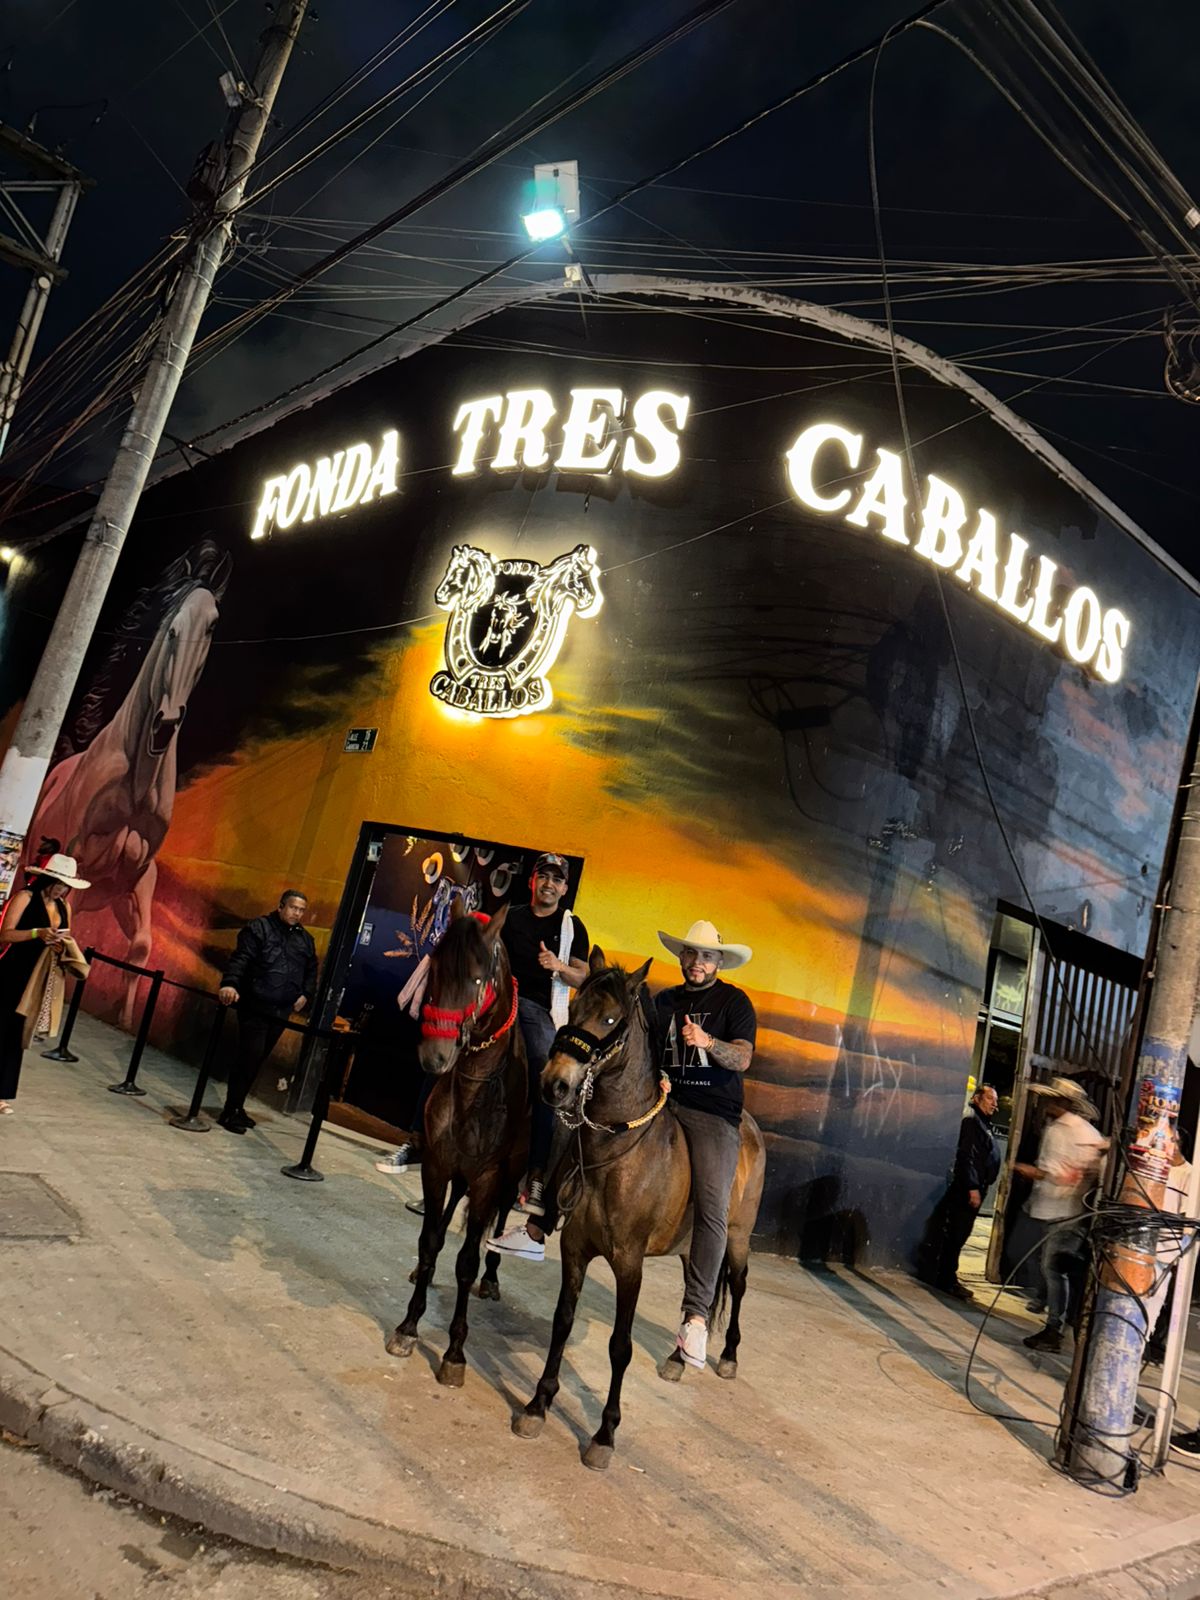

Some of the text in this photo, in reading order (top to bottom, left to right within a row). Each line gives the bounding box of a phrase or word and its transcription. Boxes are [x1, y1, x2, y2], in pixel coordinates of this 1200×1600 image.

[250, 388, 1130, 682] FONDA TRES CABALLOS
[494, 561, 540, 577] FONDA
[432, 676, 544, 712] CABALLOS
[470, 674, 506, 690] TRES
